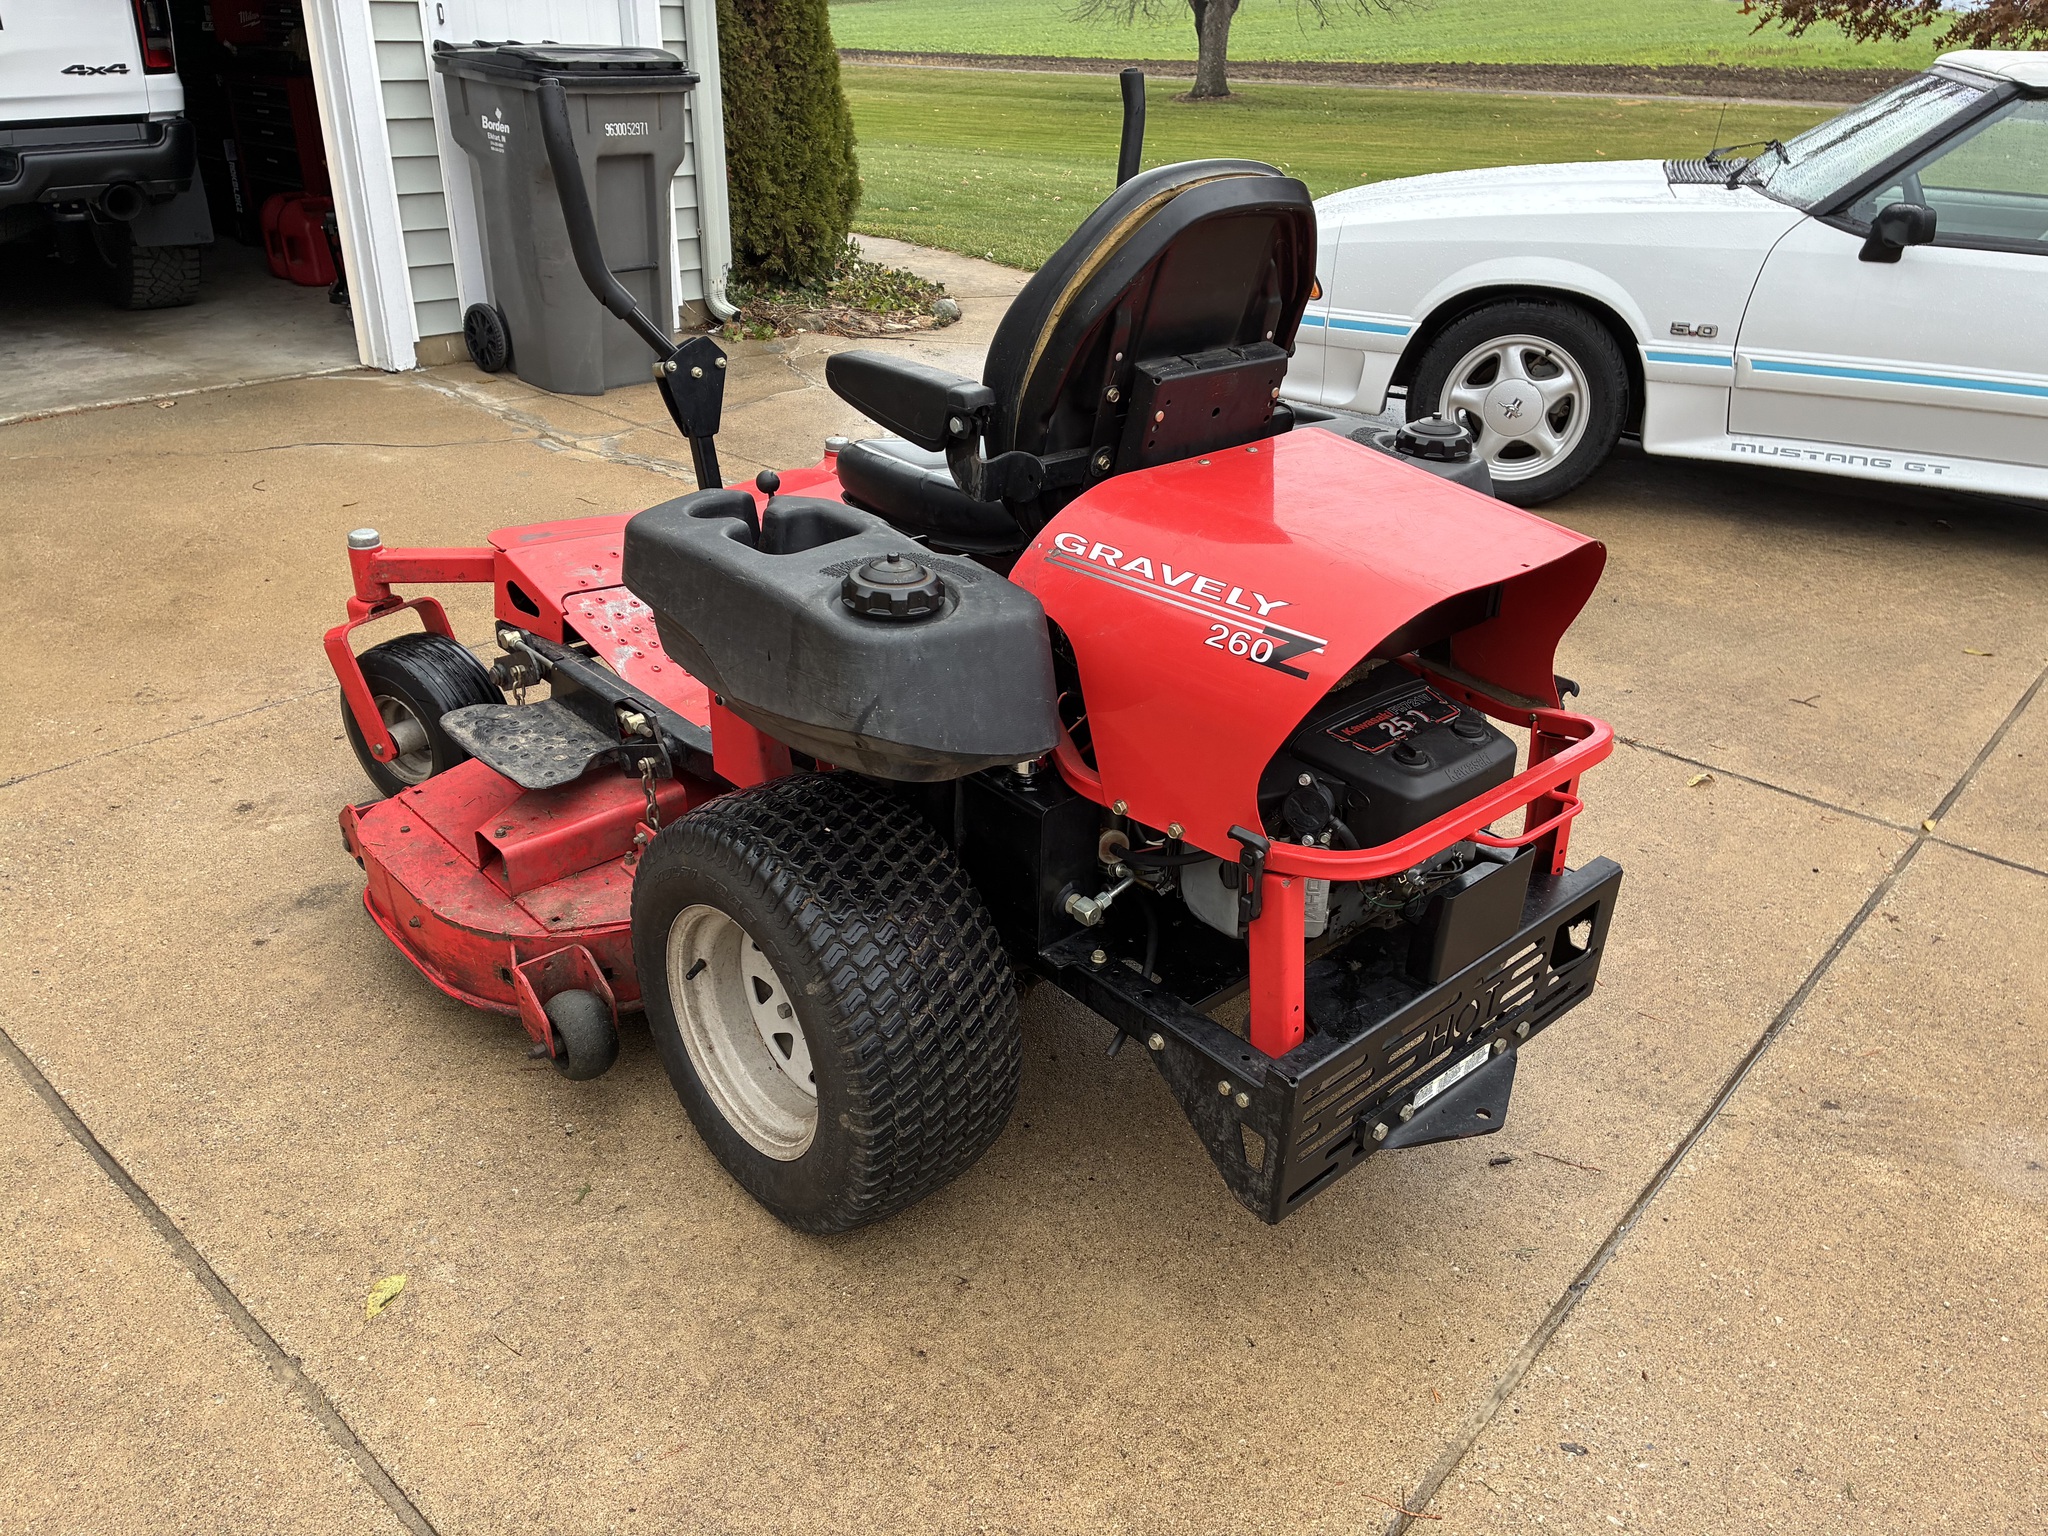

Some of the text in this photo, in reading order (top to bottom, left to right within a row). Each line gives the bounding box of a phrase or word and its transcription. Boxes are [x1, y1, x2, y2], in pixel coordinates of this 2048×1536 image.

[60, 63, 131, 76] 4x4
[481, 115, 510, 134] Borden
[1669, 321, 1719, 338] 5.0
[1730, 442, 1951, 475] MUSTANG GT
[1053, 532, 1293, 617] GRAVELY
[1340, 709, 1396, 737] Kawasaki
[1444, 752, 1494, 783] Kawasaki
[1428, 980, 1505, 1057] HOT
